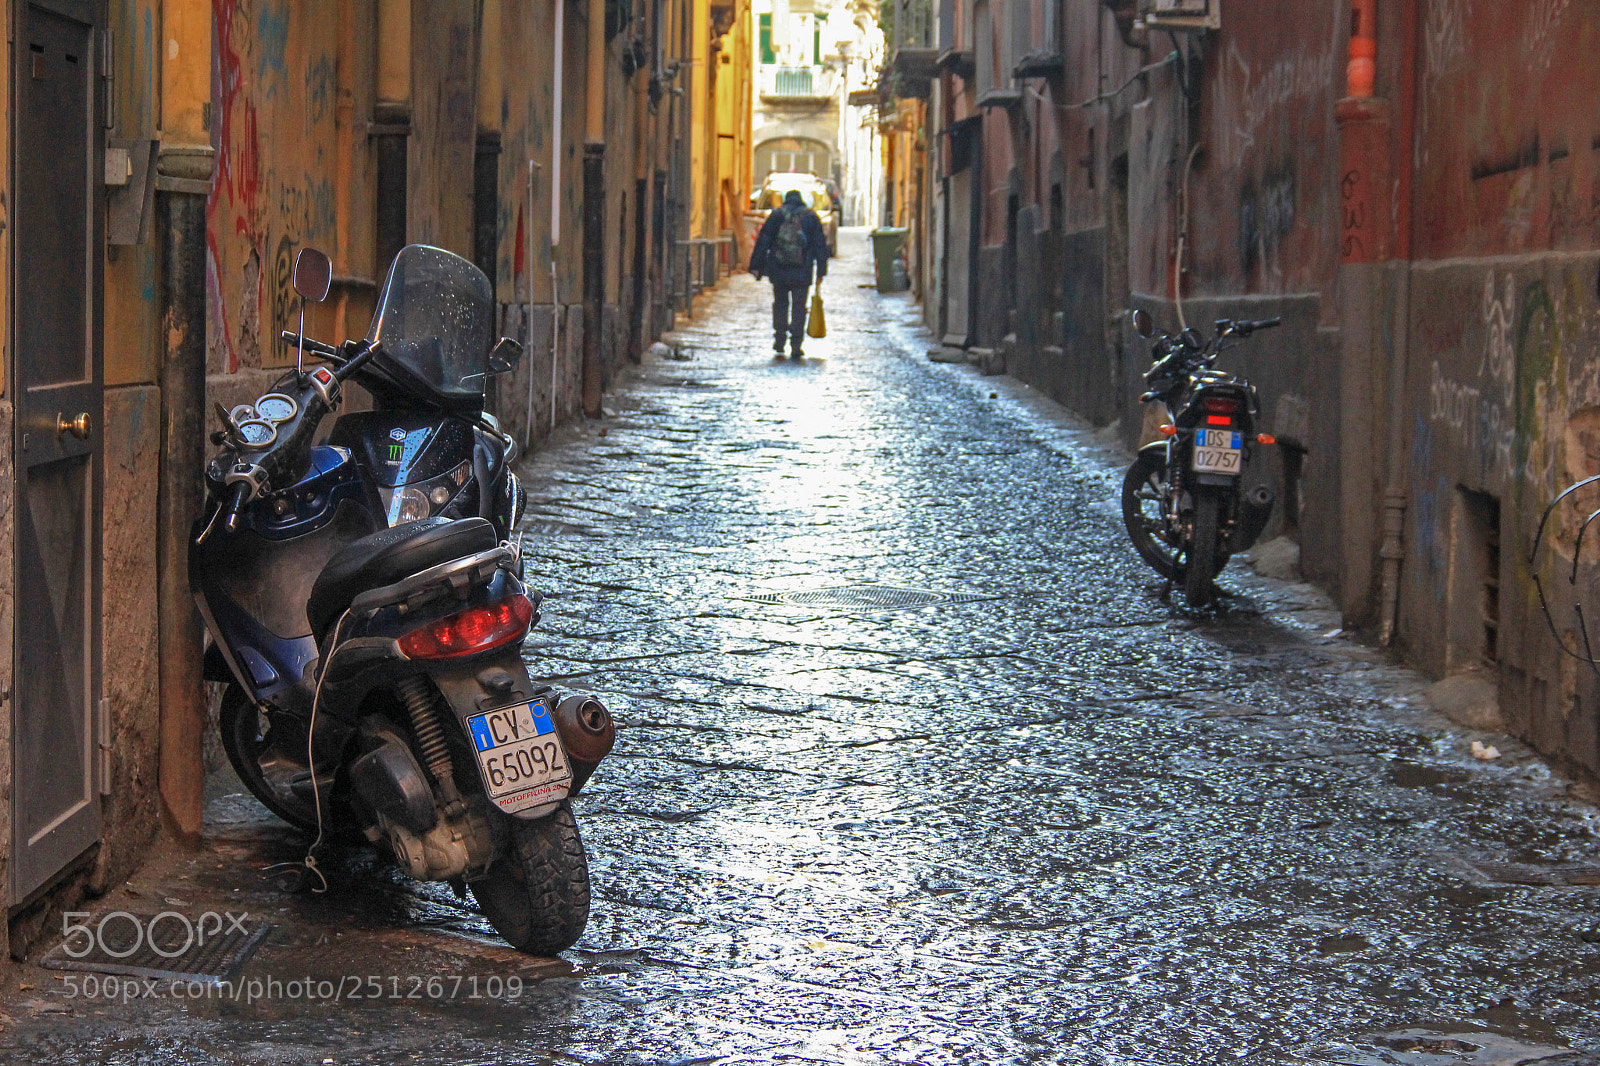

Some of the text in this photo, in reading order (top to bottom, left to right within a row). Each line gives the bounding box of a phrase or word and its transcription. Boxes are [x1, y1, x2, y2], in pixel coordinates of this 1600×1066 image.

[1207, 430, 1224, 447] DS
[1197, 450, 1239, 468] 02757
[489, 710, 519, 743] CV
[487, 742, 563, 787] 65092
